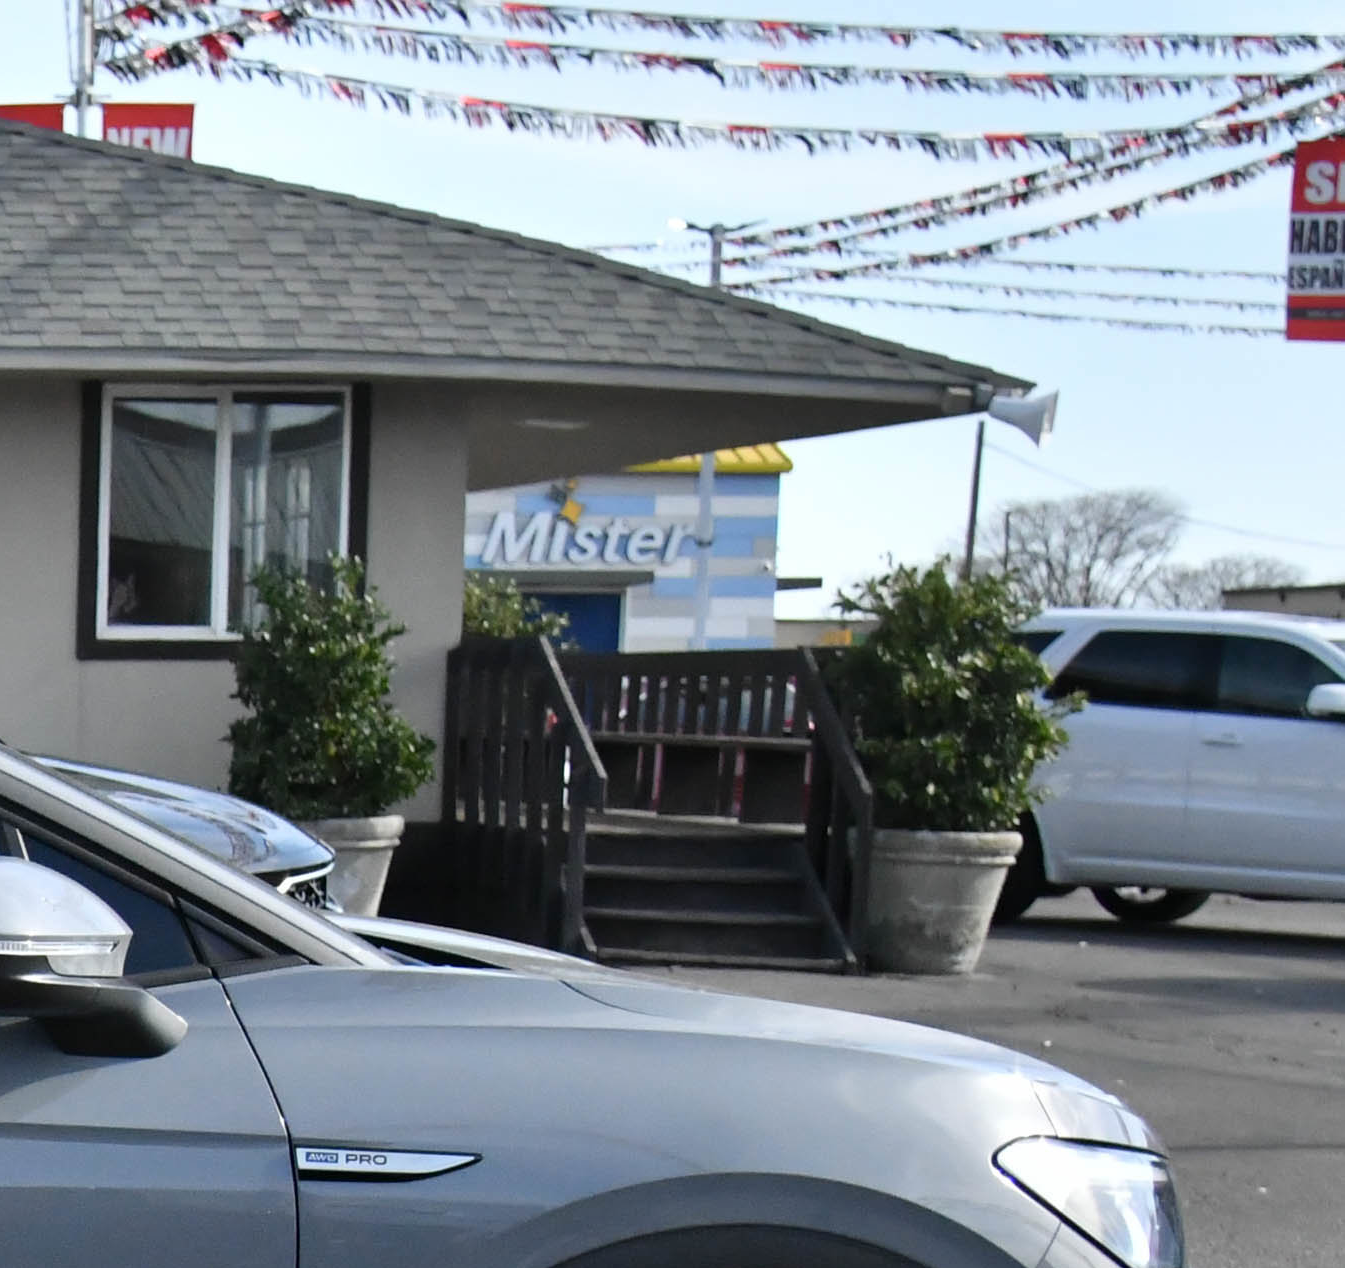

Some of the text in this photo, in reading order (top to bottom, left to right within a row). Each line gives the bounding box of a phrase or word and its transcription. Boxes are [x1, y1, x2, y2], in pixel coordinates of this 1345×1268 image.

[1304, 160, 1345, 204] S
[482, 509, 697, 565] Mister
[345, 1153, 388, 1166] PRO
